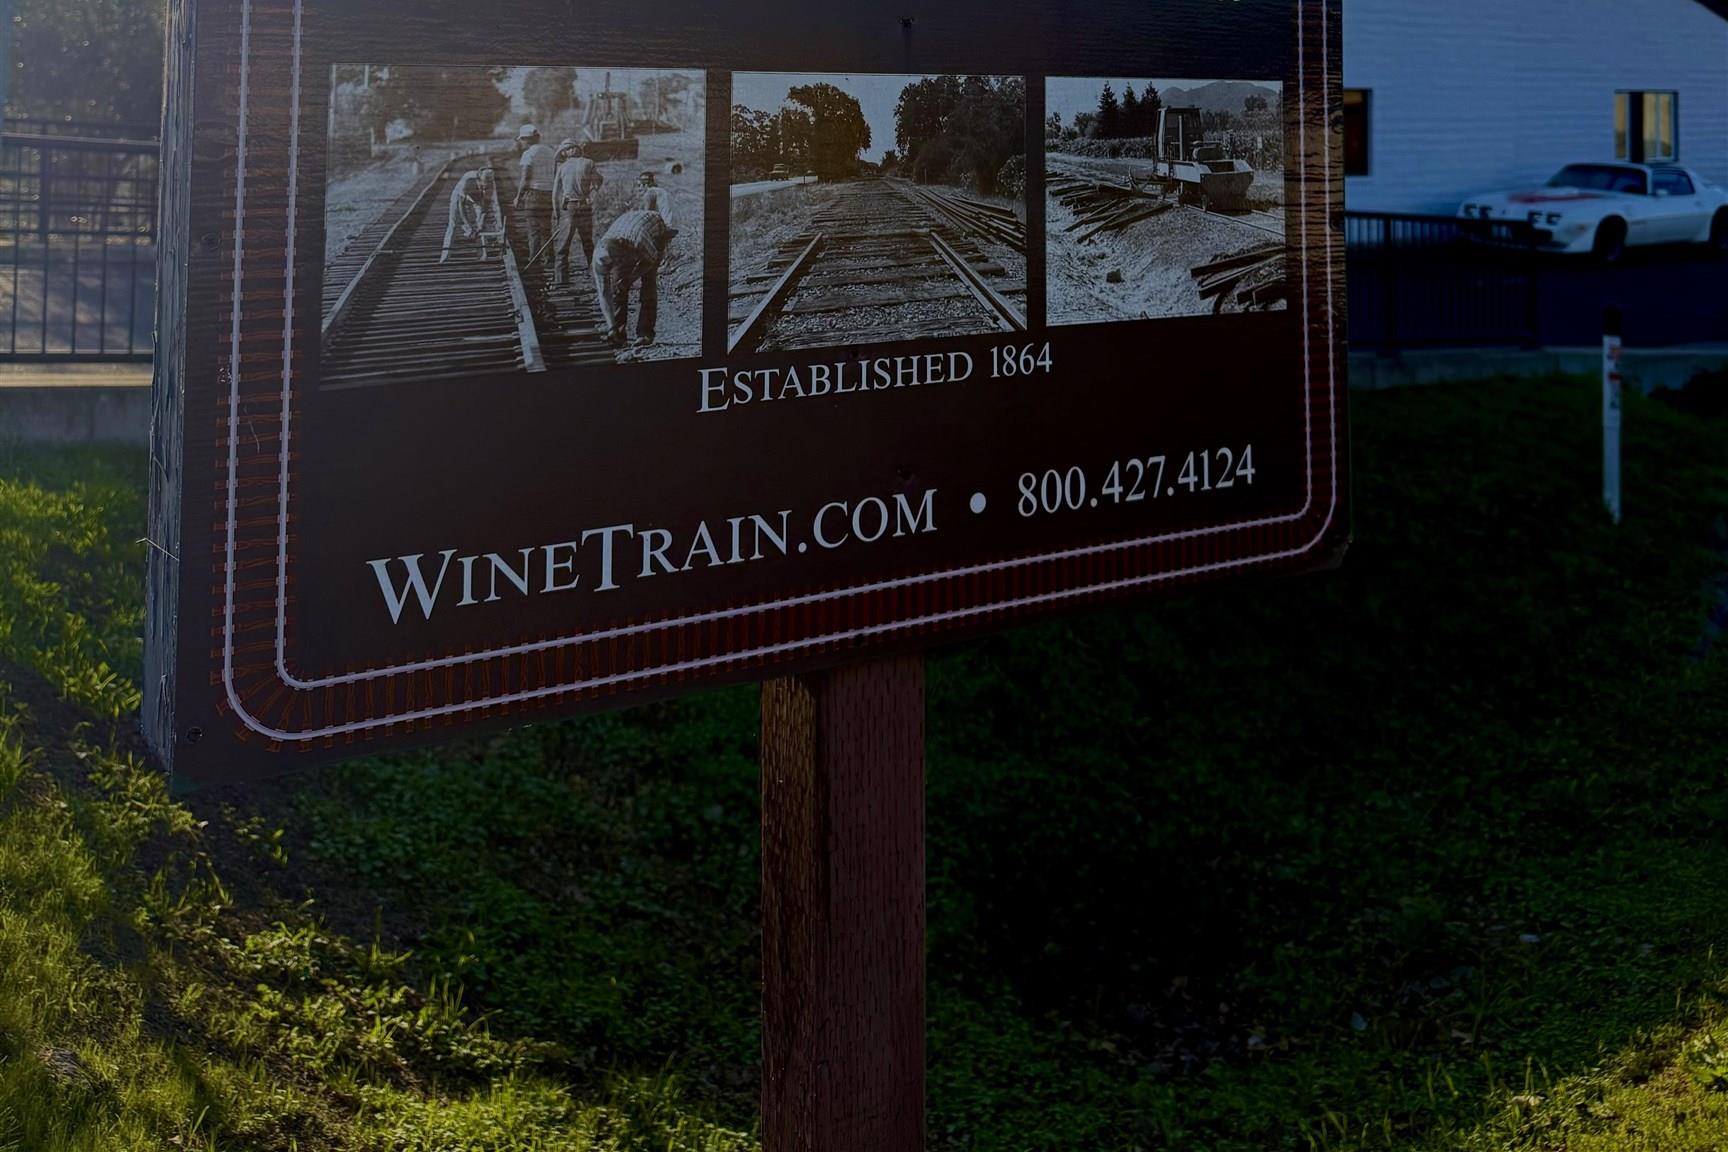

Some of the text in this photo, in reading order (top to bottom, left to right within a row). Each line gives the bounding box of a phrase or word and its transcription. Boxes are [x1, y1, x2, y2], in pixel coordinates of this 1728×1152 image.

[696, 341, 1053, 413] ESTABLISHED 1864
[365, 444, 1257, 624] WINETRAIN.COM 800.427.4124
